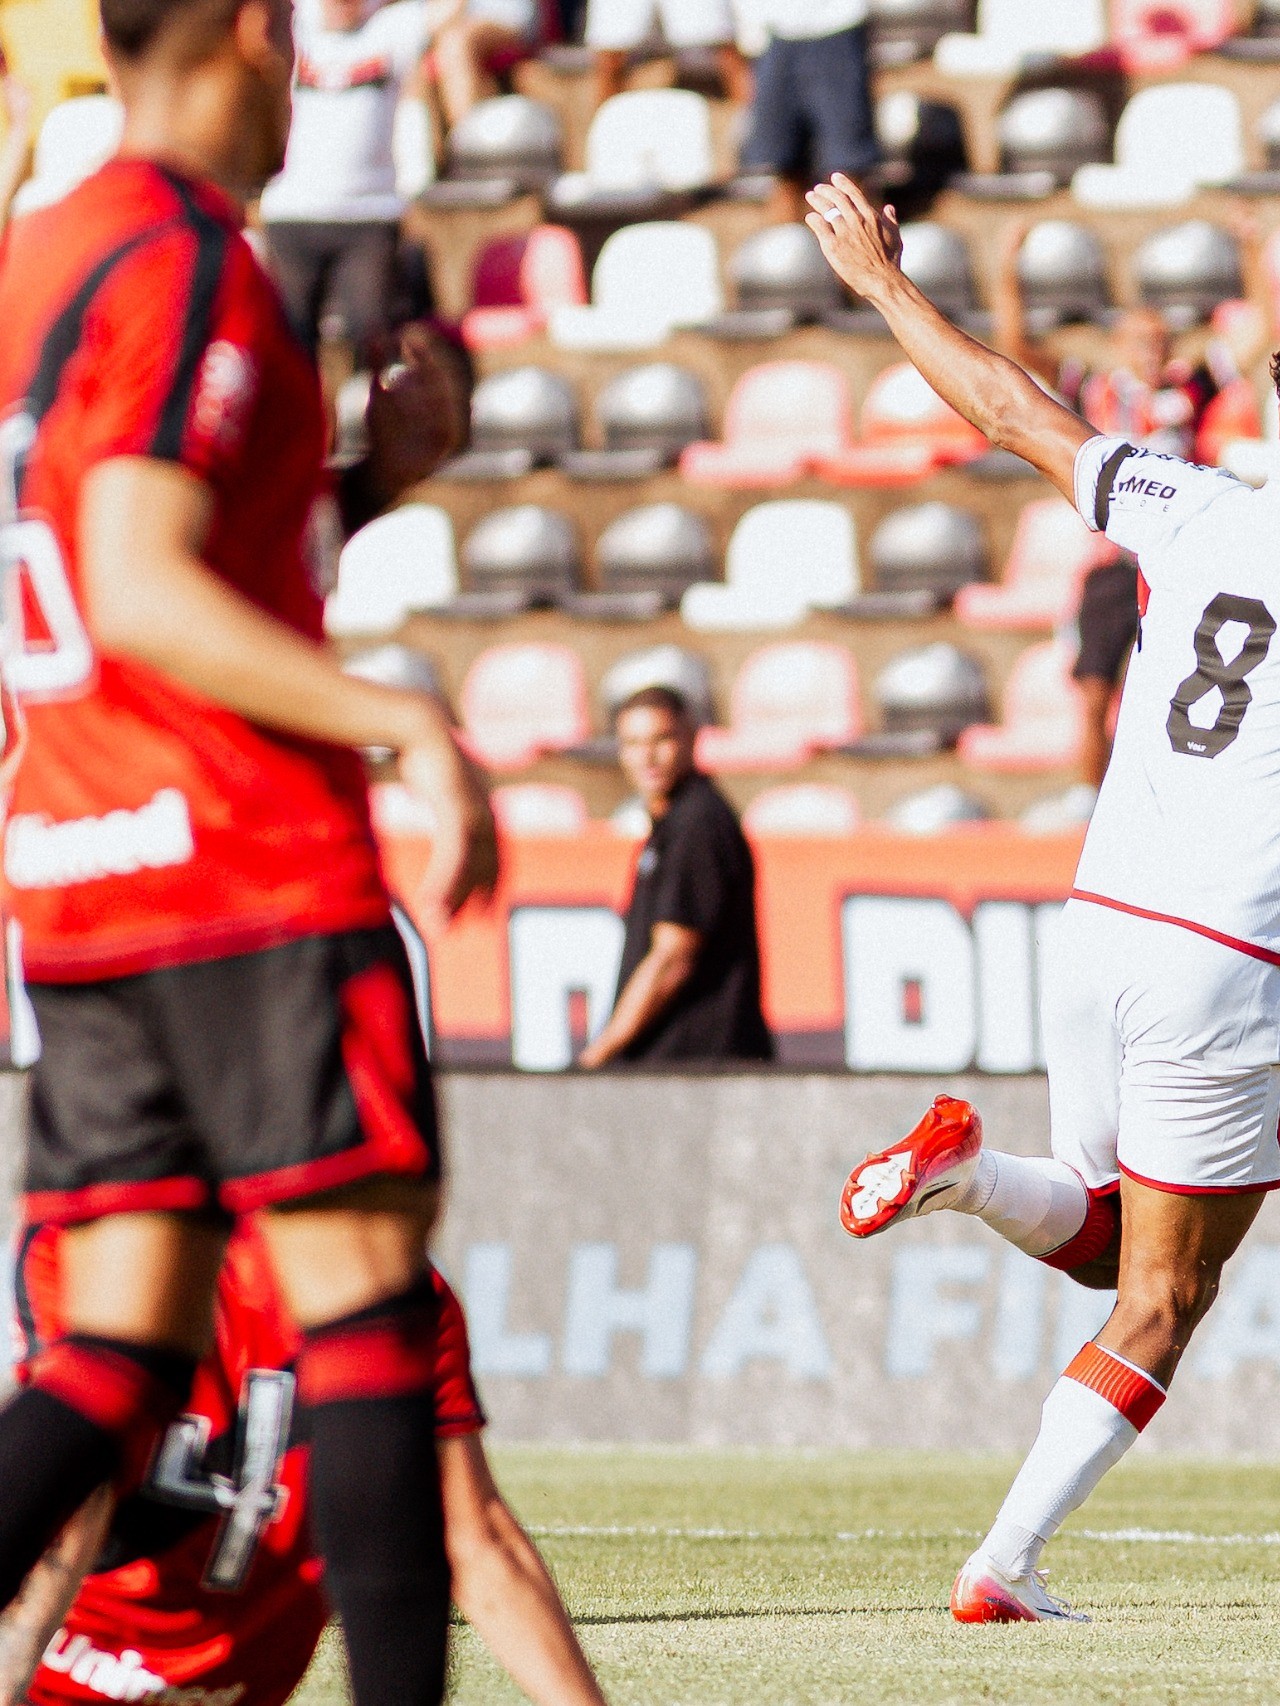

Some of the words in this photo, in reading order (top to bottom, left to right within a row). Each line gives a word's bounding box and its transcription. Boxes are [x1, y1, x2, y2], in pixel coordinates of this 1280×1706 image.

[1165, 586, 1278, 760] 8
[430, 1243, 832, 1380] LHA
[140, 1367, 297, 1591] 4
